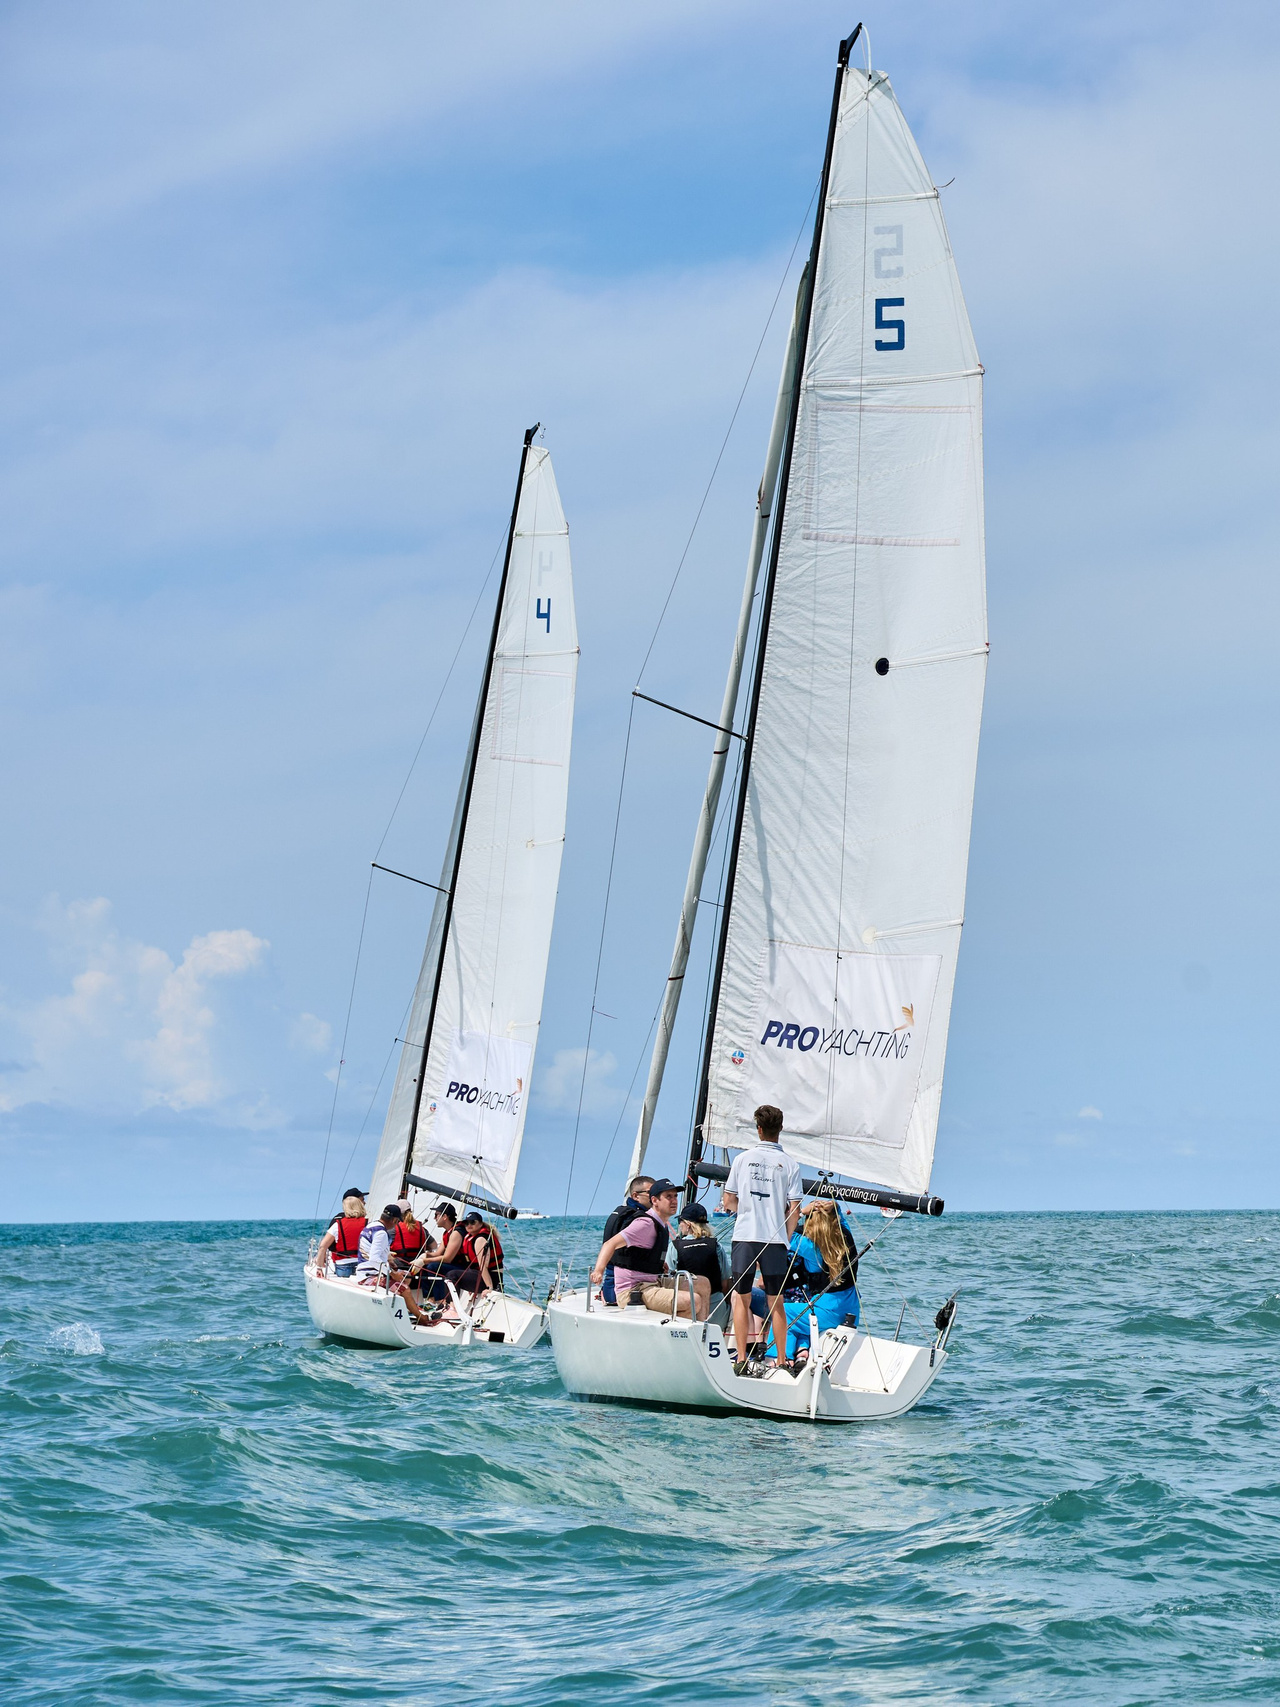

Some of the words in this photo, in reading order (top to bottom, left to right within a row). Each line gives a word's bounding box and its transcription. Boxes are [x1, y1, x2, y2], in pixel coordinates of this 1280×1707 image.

[875, 297, 905, 351] 5
[536, 598, 551, 634] 4
[760, 1020, 912, 1059] PROYACHTING
[820, 1184, 879, 1203] pro-yachting.ru
[394, 1309, 403, 1320] 4
[708, 1342, 721, 1358] 5
